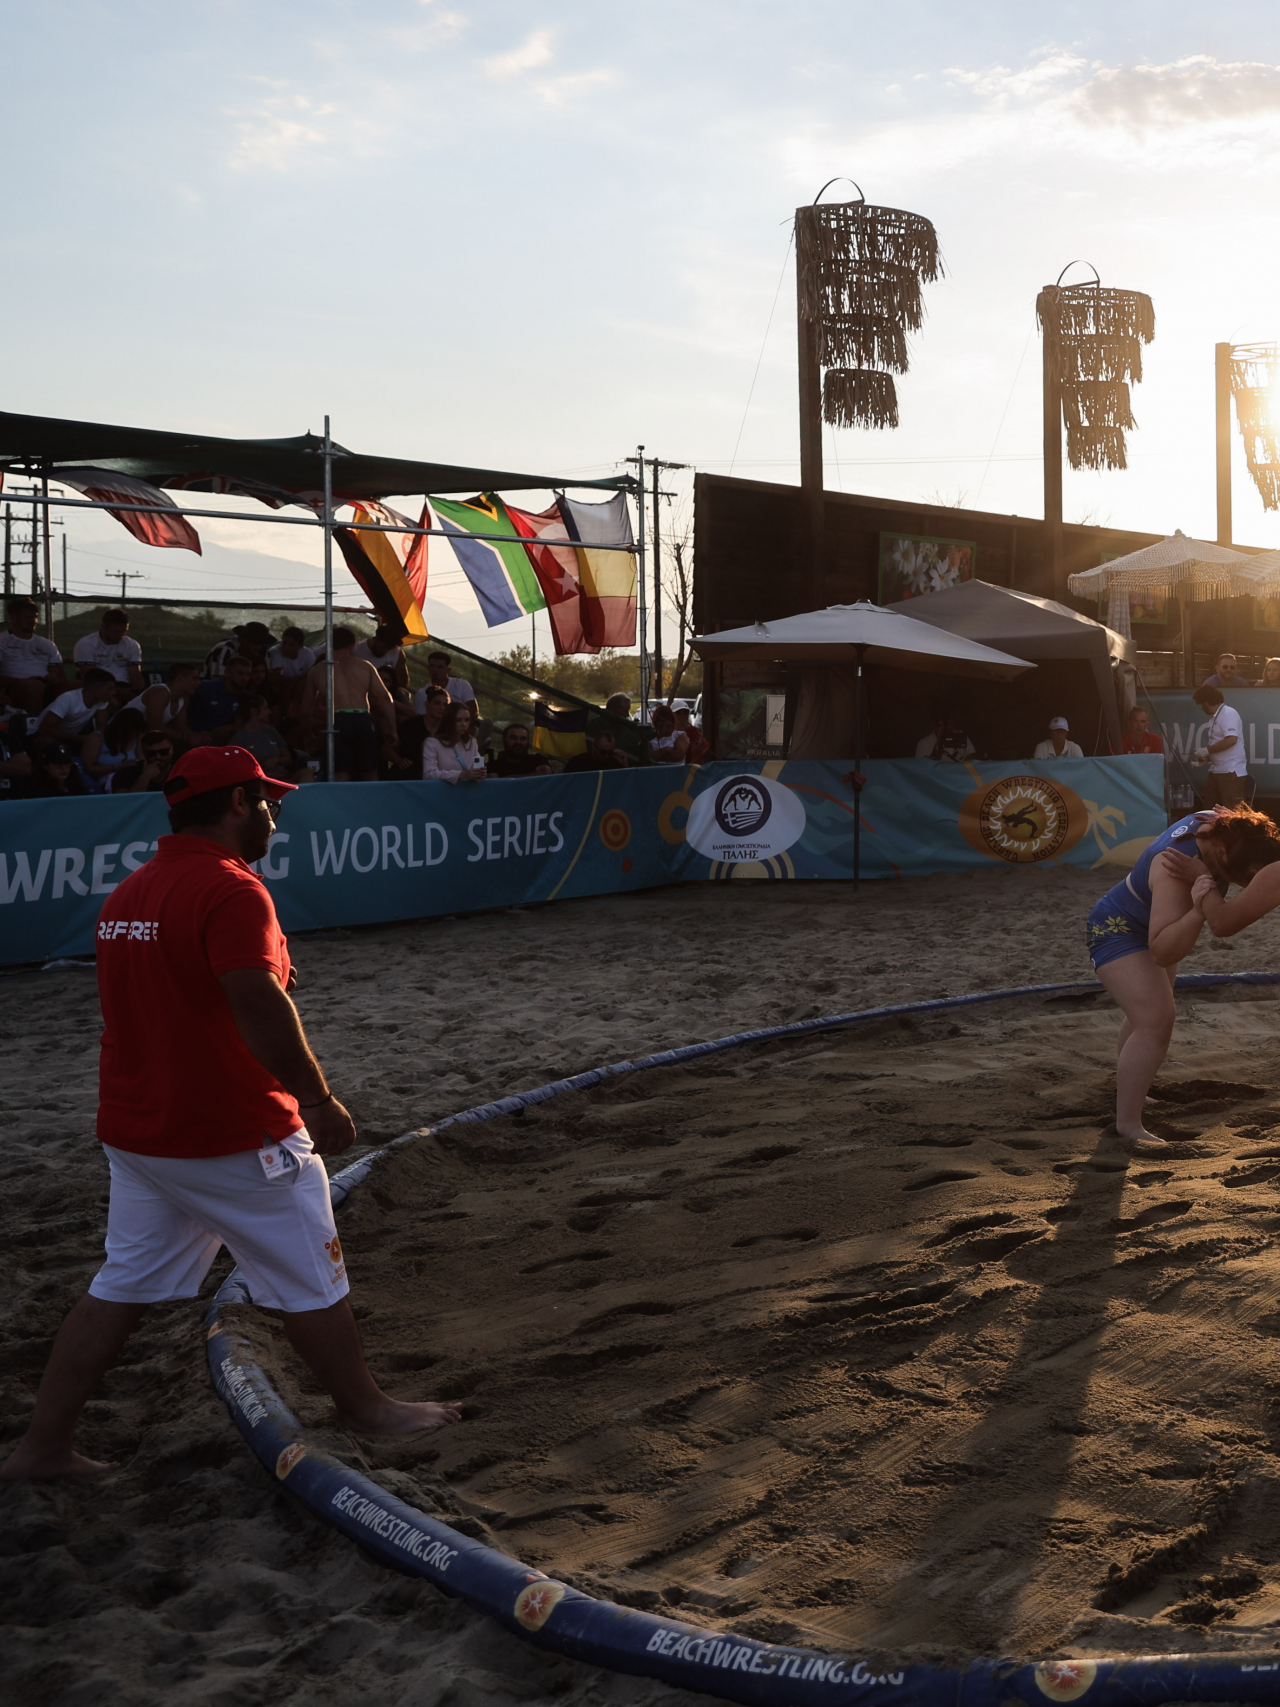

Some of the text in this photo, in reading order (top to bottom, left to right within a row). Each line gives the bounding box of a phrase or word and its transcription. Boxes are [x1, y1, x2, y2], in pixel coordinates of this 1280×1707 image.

[0, 811, 564, 905] WRESG WORLD SERIES
[723, 850, 759, 860] ΠΑΛΗΣ
[982, 788, 1001, 821] BEACH
[1002, 778, 1060, 804] WRESTLING
[1032, 805, 1067, 860] FEDERATION
[331, 1485, 459, 1571] BEACHWRESTLING.ORG
